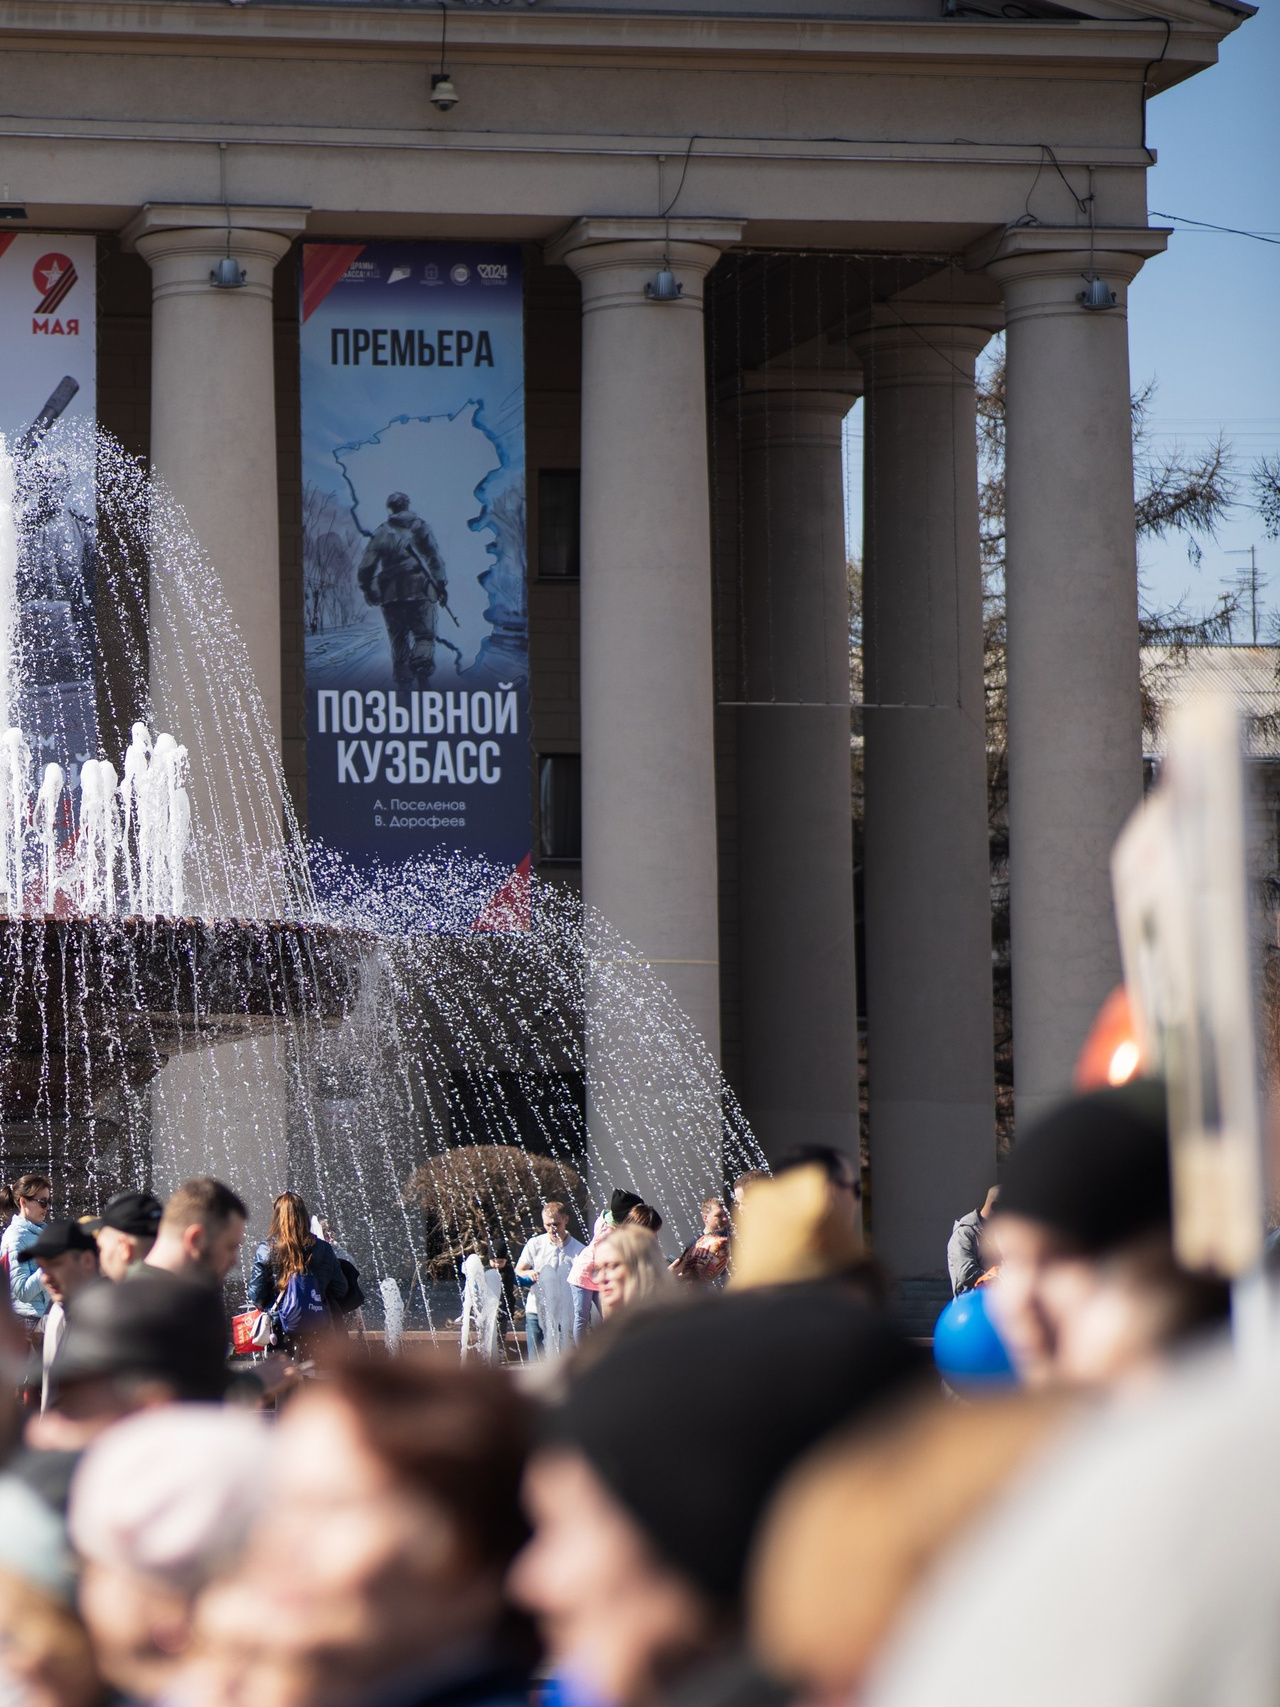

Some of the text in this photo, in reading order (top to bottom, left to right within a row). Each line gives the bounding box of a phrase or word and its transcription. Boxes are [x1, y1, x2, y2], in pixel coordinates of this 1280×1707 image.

[483, 264, 508, 279] 2024
[32, 318, 79, 335] МАЯ
[331, 328, 494, 367] ПРЕМЬЕРА
[317, 682, 518, 735] ПОЗЫВНОЙ
[337, 740, 502, 784] КУЗБАСС
[373, 799, 466, 811] А. Поселенов
[375, 815, 466, 829] В. Дорофеев
